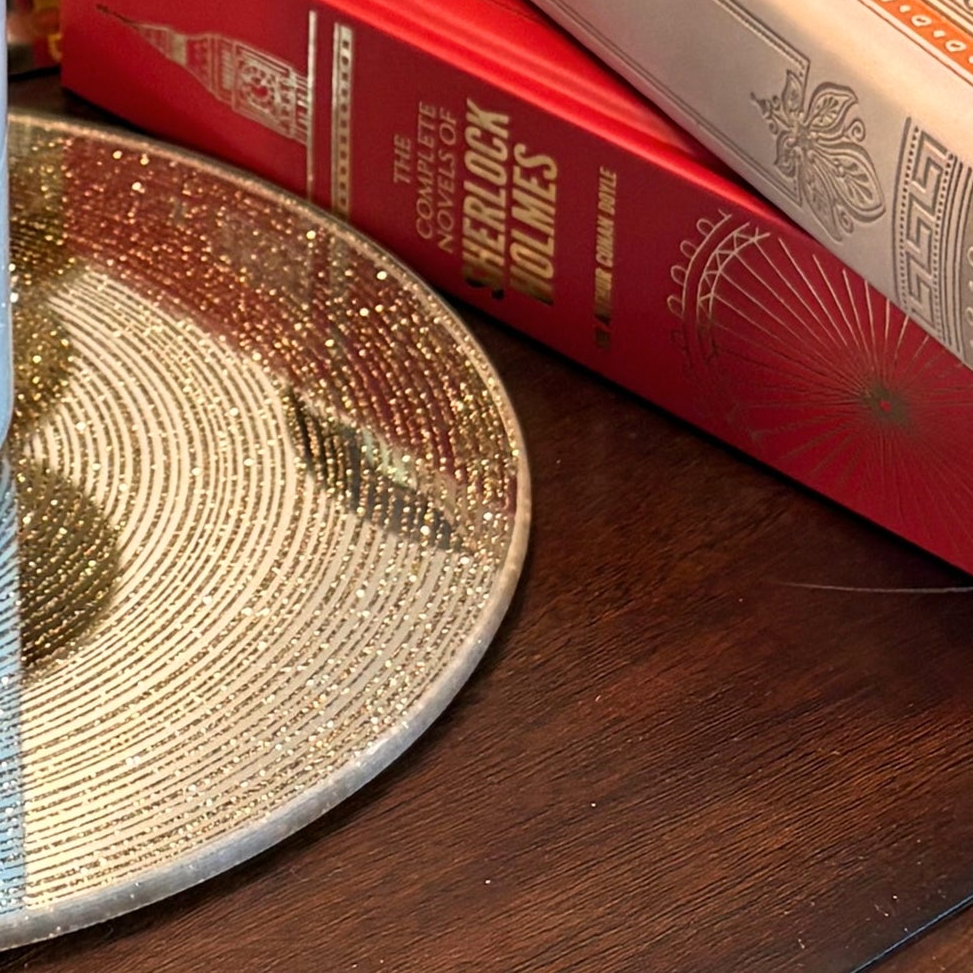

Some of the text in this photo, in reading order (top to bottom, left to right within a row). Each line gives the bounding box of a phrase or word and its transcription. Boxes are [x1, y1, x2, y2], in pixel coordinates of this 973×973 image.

[394, 135, 411, 184] THE
[416, 101, 437, 240] COMPLETE
[437, 106, 457, 254] NOVELS OF
[598, 166, 617, 216] DOYLE
[509, 143, 558, 306] HOLMES
[595, 214, 615, 268] CONAN
